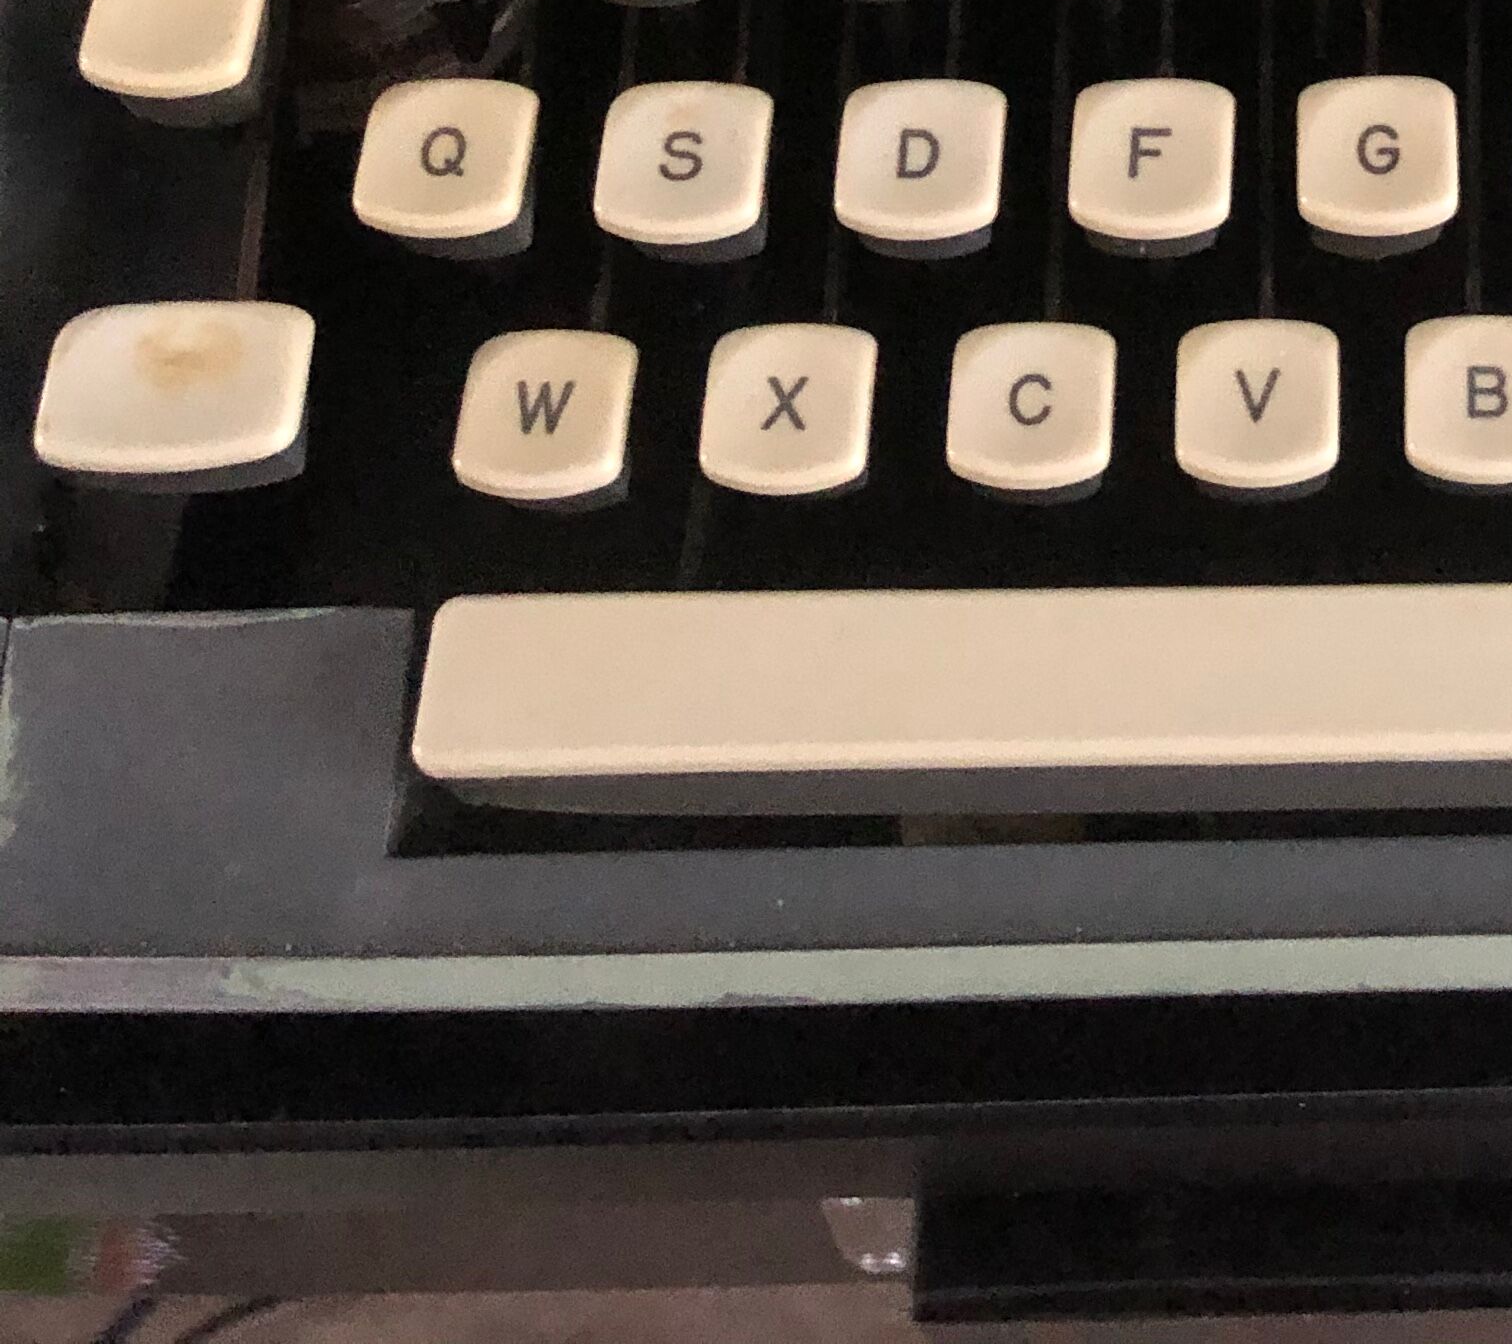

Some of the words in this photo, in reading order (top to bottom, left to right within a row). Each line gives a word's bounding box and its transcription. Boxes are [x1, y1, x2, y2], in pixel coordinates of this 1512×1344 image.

[420, 126, 467, 178] Q
[658, 130, 704, 182] S
[896, 128, 941, 180] D
[1127, 126, 1172, 179] F
[1356, 124, 1401, 176] G
[517, 380, 575, 436] W
[760, 376, 809, 431] X
[1008, 373, 1052, 427] C
[1235, 368, 1281, 424] V
[1466, 365, 1509, 420] B
